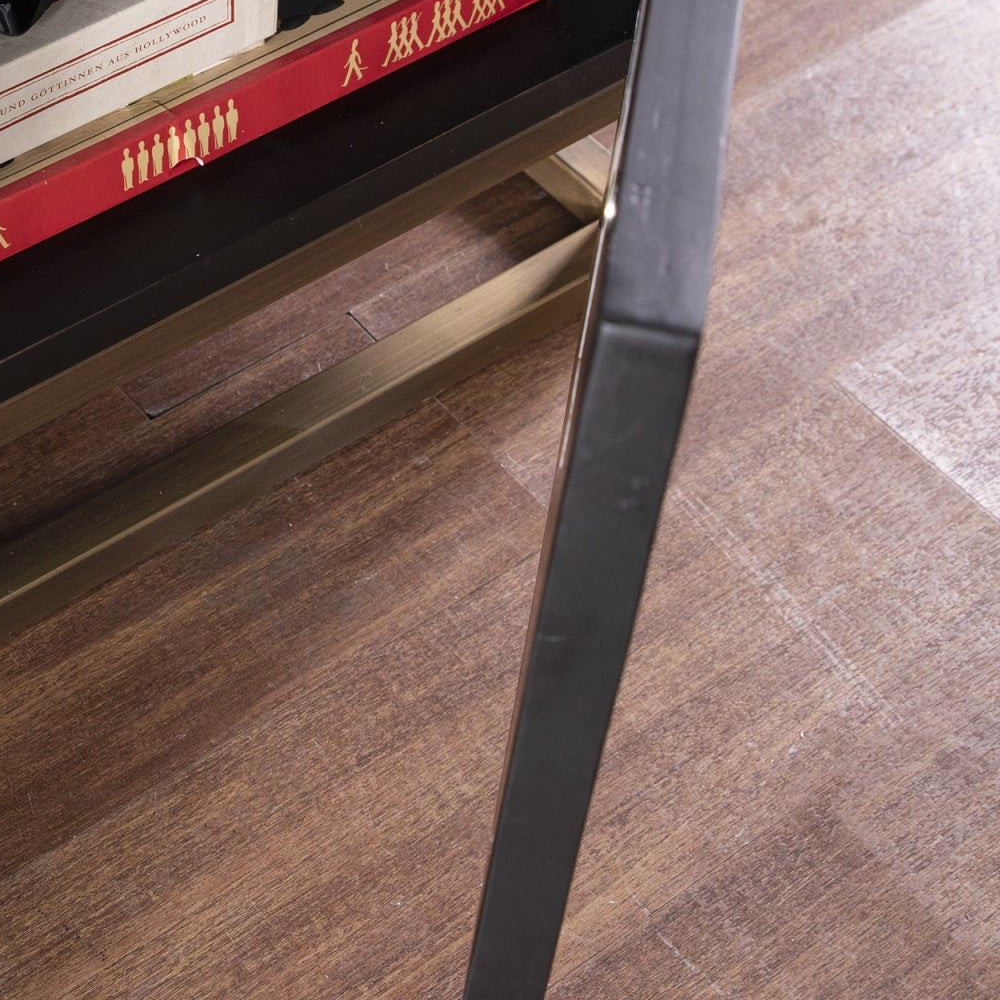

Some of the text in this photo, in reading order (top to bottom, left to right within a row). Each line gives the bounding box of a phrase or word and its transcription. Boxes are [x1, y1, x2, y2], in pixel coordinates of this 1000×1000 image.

[0, 99, 26, 116] UND
[30, 63, 103, 102] GÖTTINNEN
[107, 51, 130, 66] AUS
[135, 15, 207, 54] HOLLYWOOD
